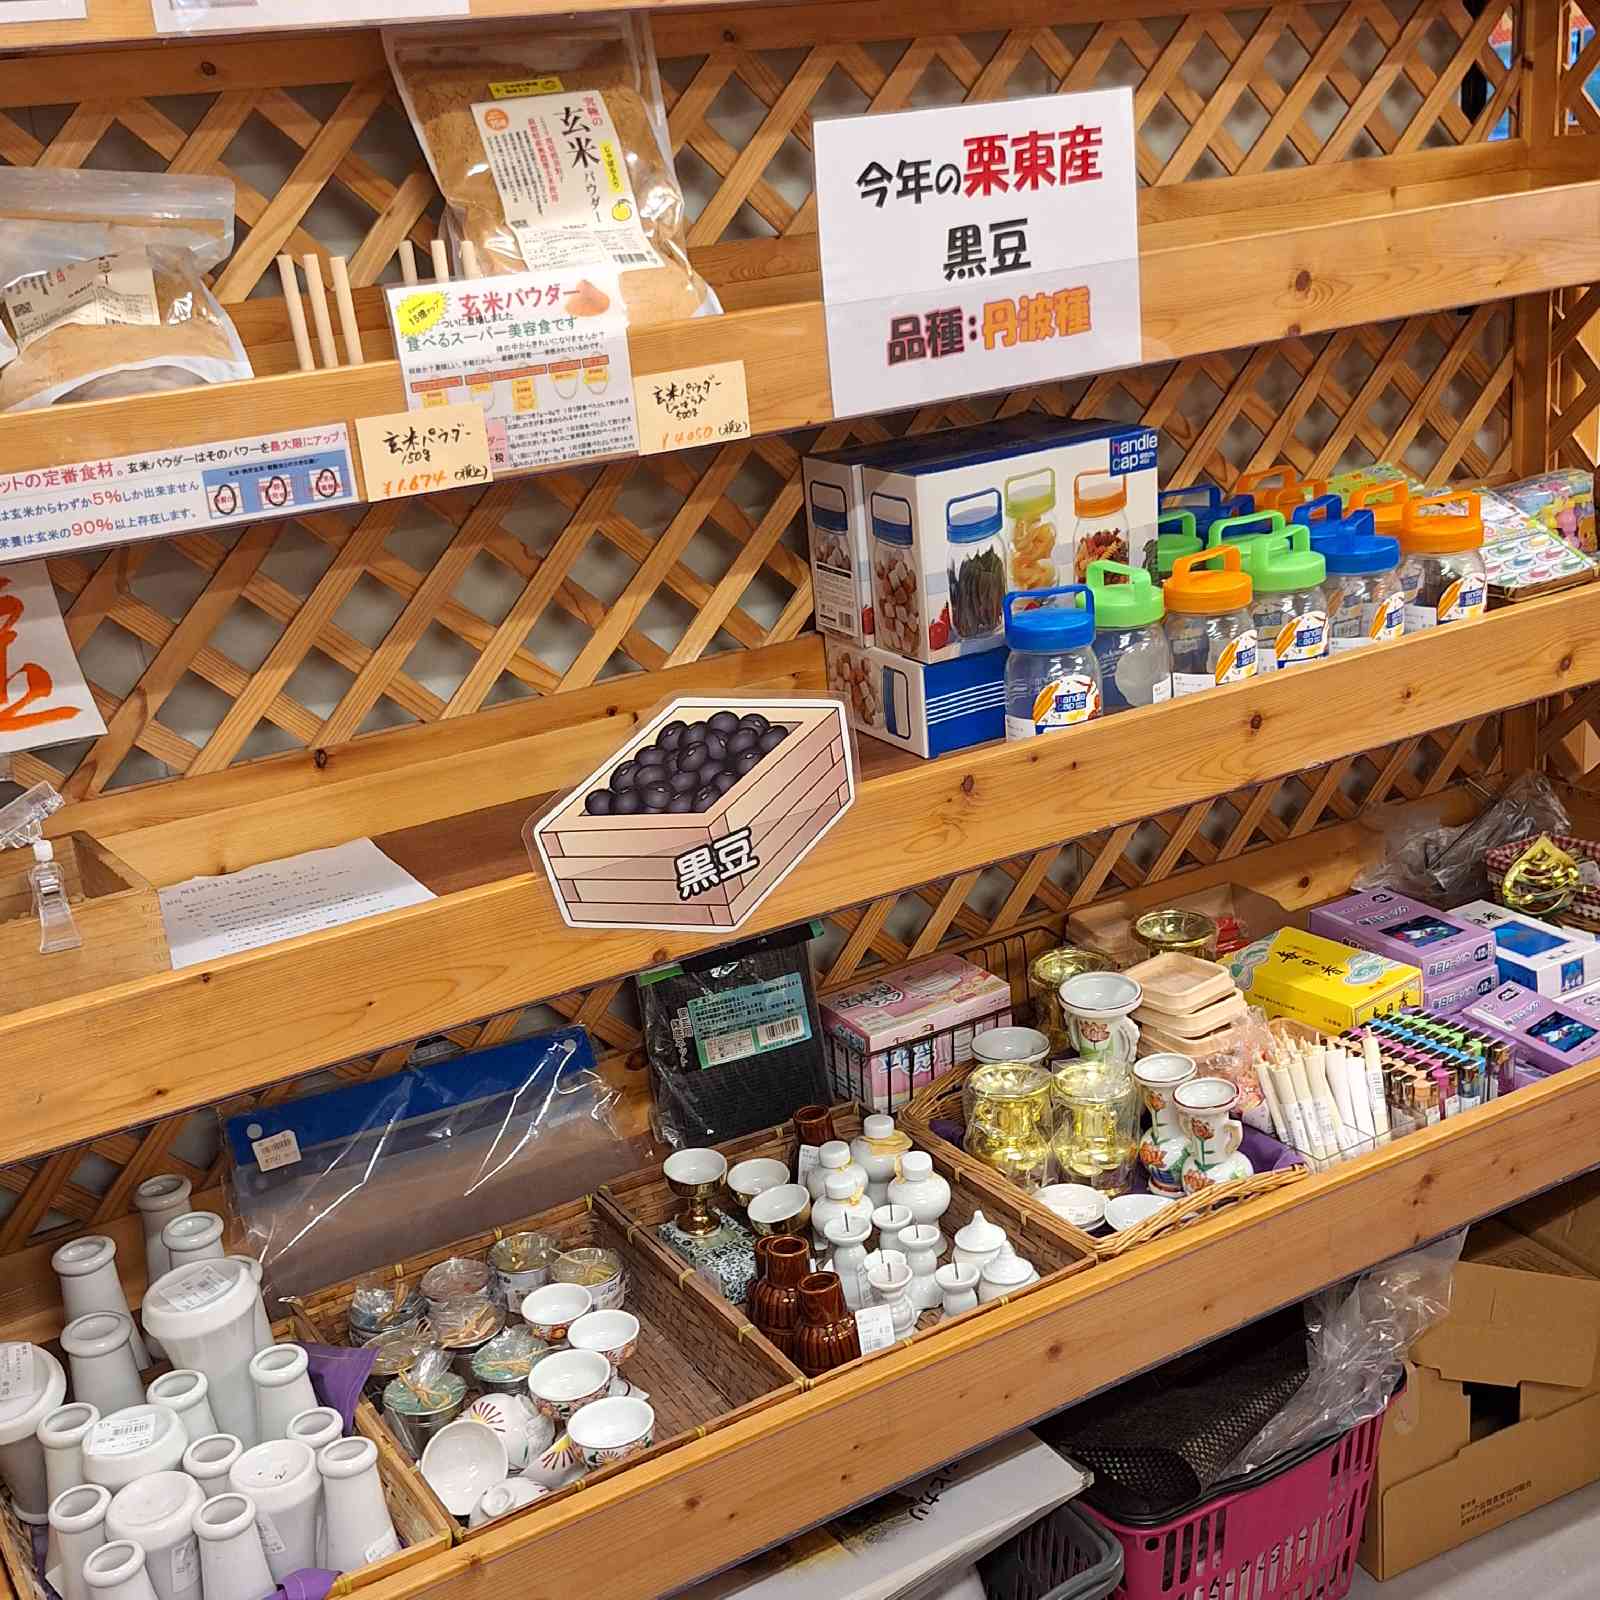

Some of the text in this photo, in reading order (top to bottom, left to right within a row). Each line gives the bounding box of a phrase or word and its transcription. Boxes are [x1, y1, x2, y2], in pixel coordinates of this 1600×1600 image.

[856, 124, 1104, 208] 今年の栗東産
[942, 217, 1032, 281] 黒豆
[440, 311, 515, 329] ついに登場しました
[458, 283, 581, 320] 玄米パウダー
[406, 316, 578, 353] 食べるスーパー美容食です
[382, 423, 471, 454] 玄米パウダー
[1111, 433, 1158, 457] handle
[1112, 454, 1138, 472] cap
[674, 826, 760, 900] 黒豆
